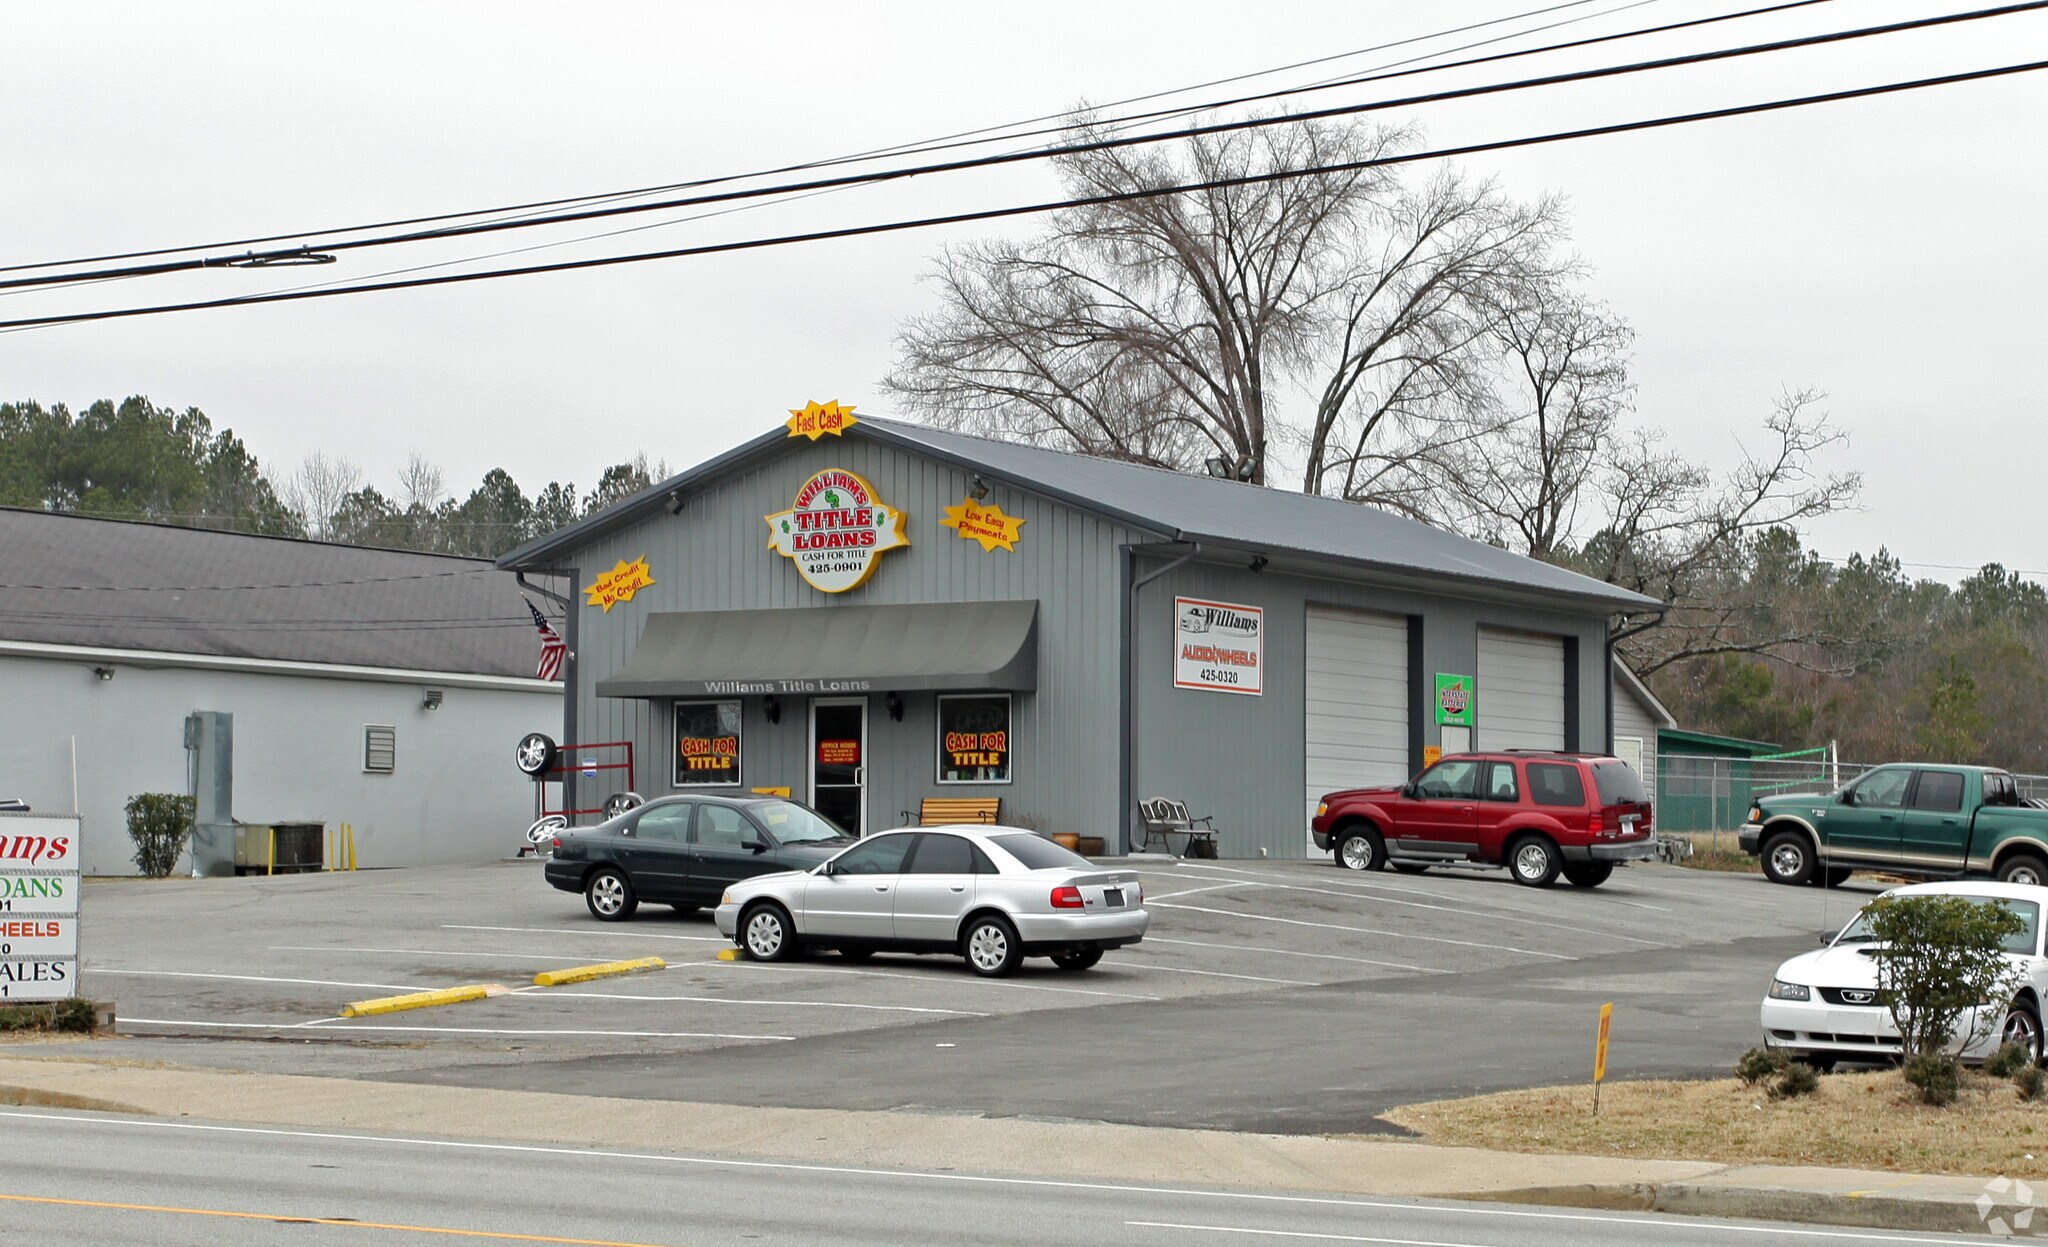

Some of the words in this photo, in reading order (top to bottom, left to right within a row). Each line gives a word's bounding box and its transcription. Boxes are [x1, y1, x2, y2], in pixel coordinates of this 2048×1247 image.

[796, 411, 816, 433] Fast
[819, 408, 842, 430] Cash
[797, 473, 868, 508] WILLIAMS
[795, 508, 872, 531] TITLE
[965, 508, 982, 521] Low
[985, 513, 1005, 530] Easy
[794, 530, 876, 550] LOANS
[958, 520, 1008, 541] Payments
[802, 552, 825, 561] CASH
[827, 551, 844, 560] FOR
[847, 550, 866, 559] TITLE
[596, 579, 612, 593] Bad
[614, 564, 640, 582] Credit
[808, 562, 863, 574] 425-0901
[603, 594, 615, 605] No
[617, 577, 642, 596] Credit
[1204, 608, 1258, 633] Williams
[704, 681, 775, 693] Williams
[779, 680, 815, 692] Title
[819, 680, 870, 691] Loans
[1200, 669, 1238, 684] 425-0320
[682, 737, 711, 756] CASH
[713, 736, 736, 757] FOR
[946, 732, 978, 752] CASH
[980, 731, 1006, 752] FOR
[688, 757, 731, 769] TITLE
[953, 752, 999, 765] TITLE
